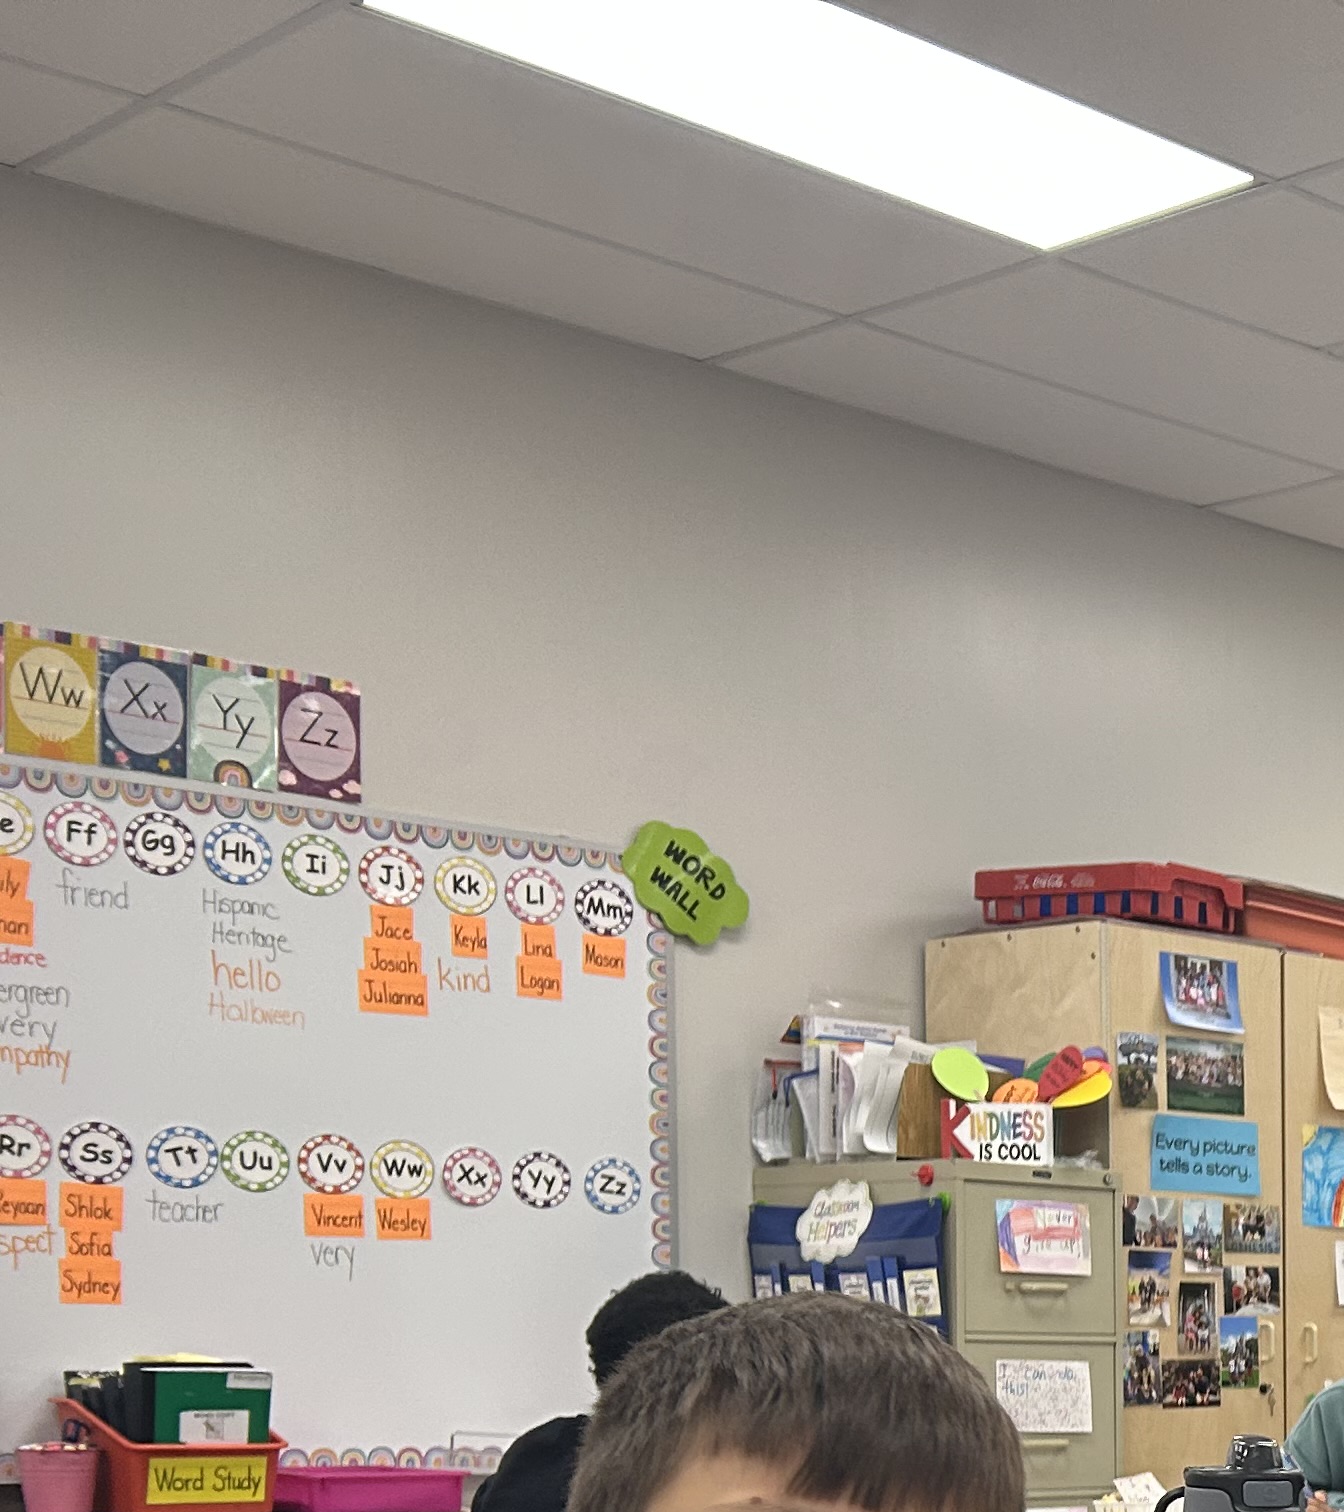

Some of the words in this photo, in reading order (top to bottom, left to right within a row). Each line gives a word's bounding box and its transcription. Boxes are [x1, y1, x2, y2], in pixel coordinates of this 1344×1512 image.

[20, 661, 84, 709] Ww
[120, 678, 168, 722] Xx
[213, 693, 255, 749] Yy
[299, 707, 340, 749] Zz
[66, 819, 98, 846] Ff
[141, 829, 176, 856] Gg
[220, 840, 257, 865] Hh
[305, 853, 327, 876] Ii
[379, 864, 405, 891] Jj
[663, 839, 726, 900] WORD
[56, 867, 129, 910] friend
[452, 874, 480, 896] Kk
[526, 885, 544, 905] Ll
[650, 865, 700, 922] WALL
[202, 888, 280, 926] Hispanic
[587, 898, 623, 919] Mm
[374, 915, 413, 940] Jace
[454, 925, 488, 951] Keyla
[212, 922, 291, 962] Heritage
[370, 948, 418, 974] Josiah
[585, 943, 625, 970] Mason
[211, 949, 281, 992] hello
[437, 957, 491, 993] kind
[520, 966, 560, 996] Logan
[362, 979, 425, 1008] Julianna
[940, 1099, 1045, 1159] KINDNESS
[79, 1142, 113, 1165] Ss
[164, 1145, 198, 1167] Tt
[979, 1143, 992, 1161] IS
[998, 1143, 1041, 1161] COOL
[1155, 1132, 1200, 1157] Every
[1203, 1138, 1256, 1157] picture
[239, 1151, 273, 1171] Uu
[317, 1153, 347, 1173] Vv
[383, 1158, 424, 1179] Ww
[1159, 1156, 1190, 1175] tells
[1192, 1163, 1203, 1175] a
[1206, 1163, 1252, 1183] story.
[456, 1164, 488, 1188] Xx
[527, 1169, 557, 1195] Yy
[599, 1174, 628, 1197] Zz
[64, 1193, 113, 1220] Shlok
[145, 1189, 224, 1223] teacher
[311, 1204, 363, 1230] Vincent
[377, 1208, 427, 1237] Wesley
[68, 1232, 112, 1257] Sofia
[311, 1243, 356, 1281] very
[61, 1269, 121, 1300] Sydney
[155, 1467, 206, 1493] Word
[212, 1466, 262, 1497] Study
